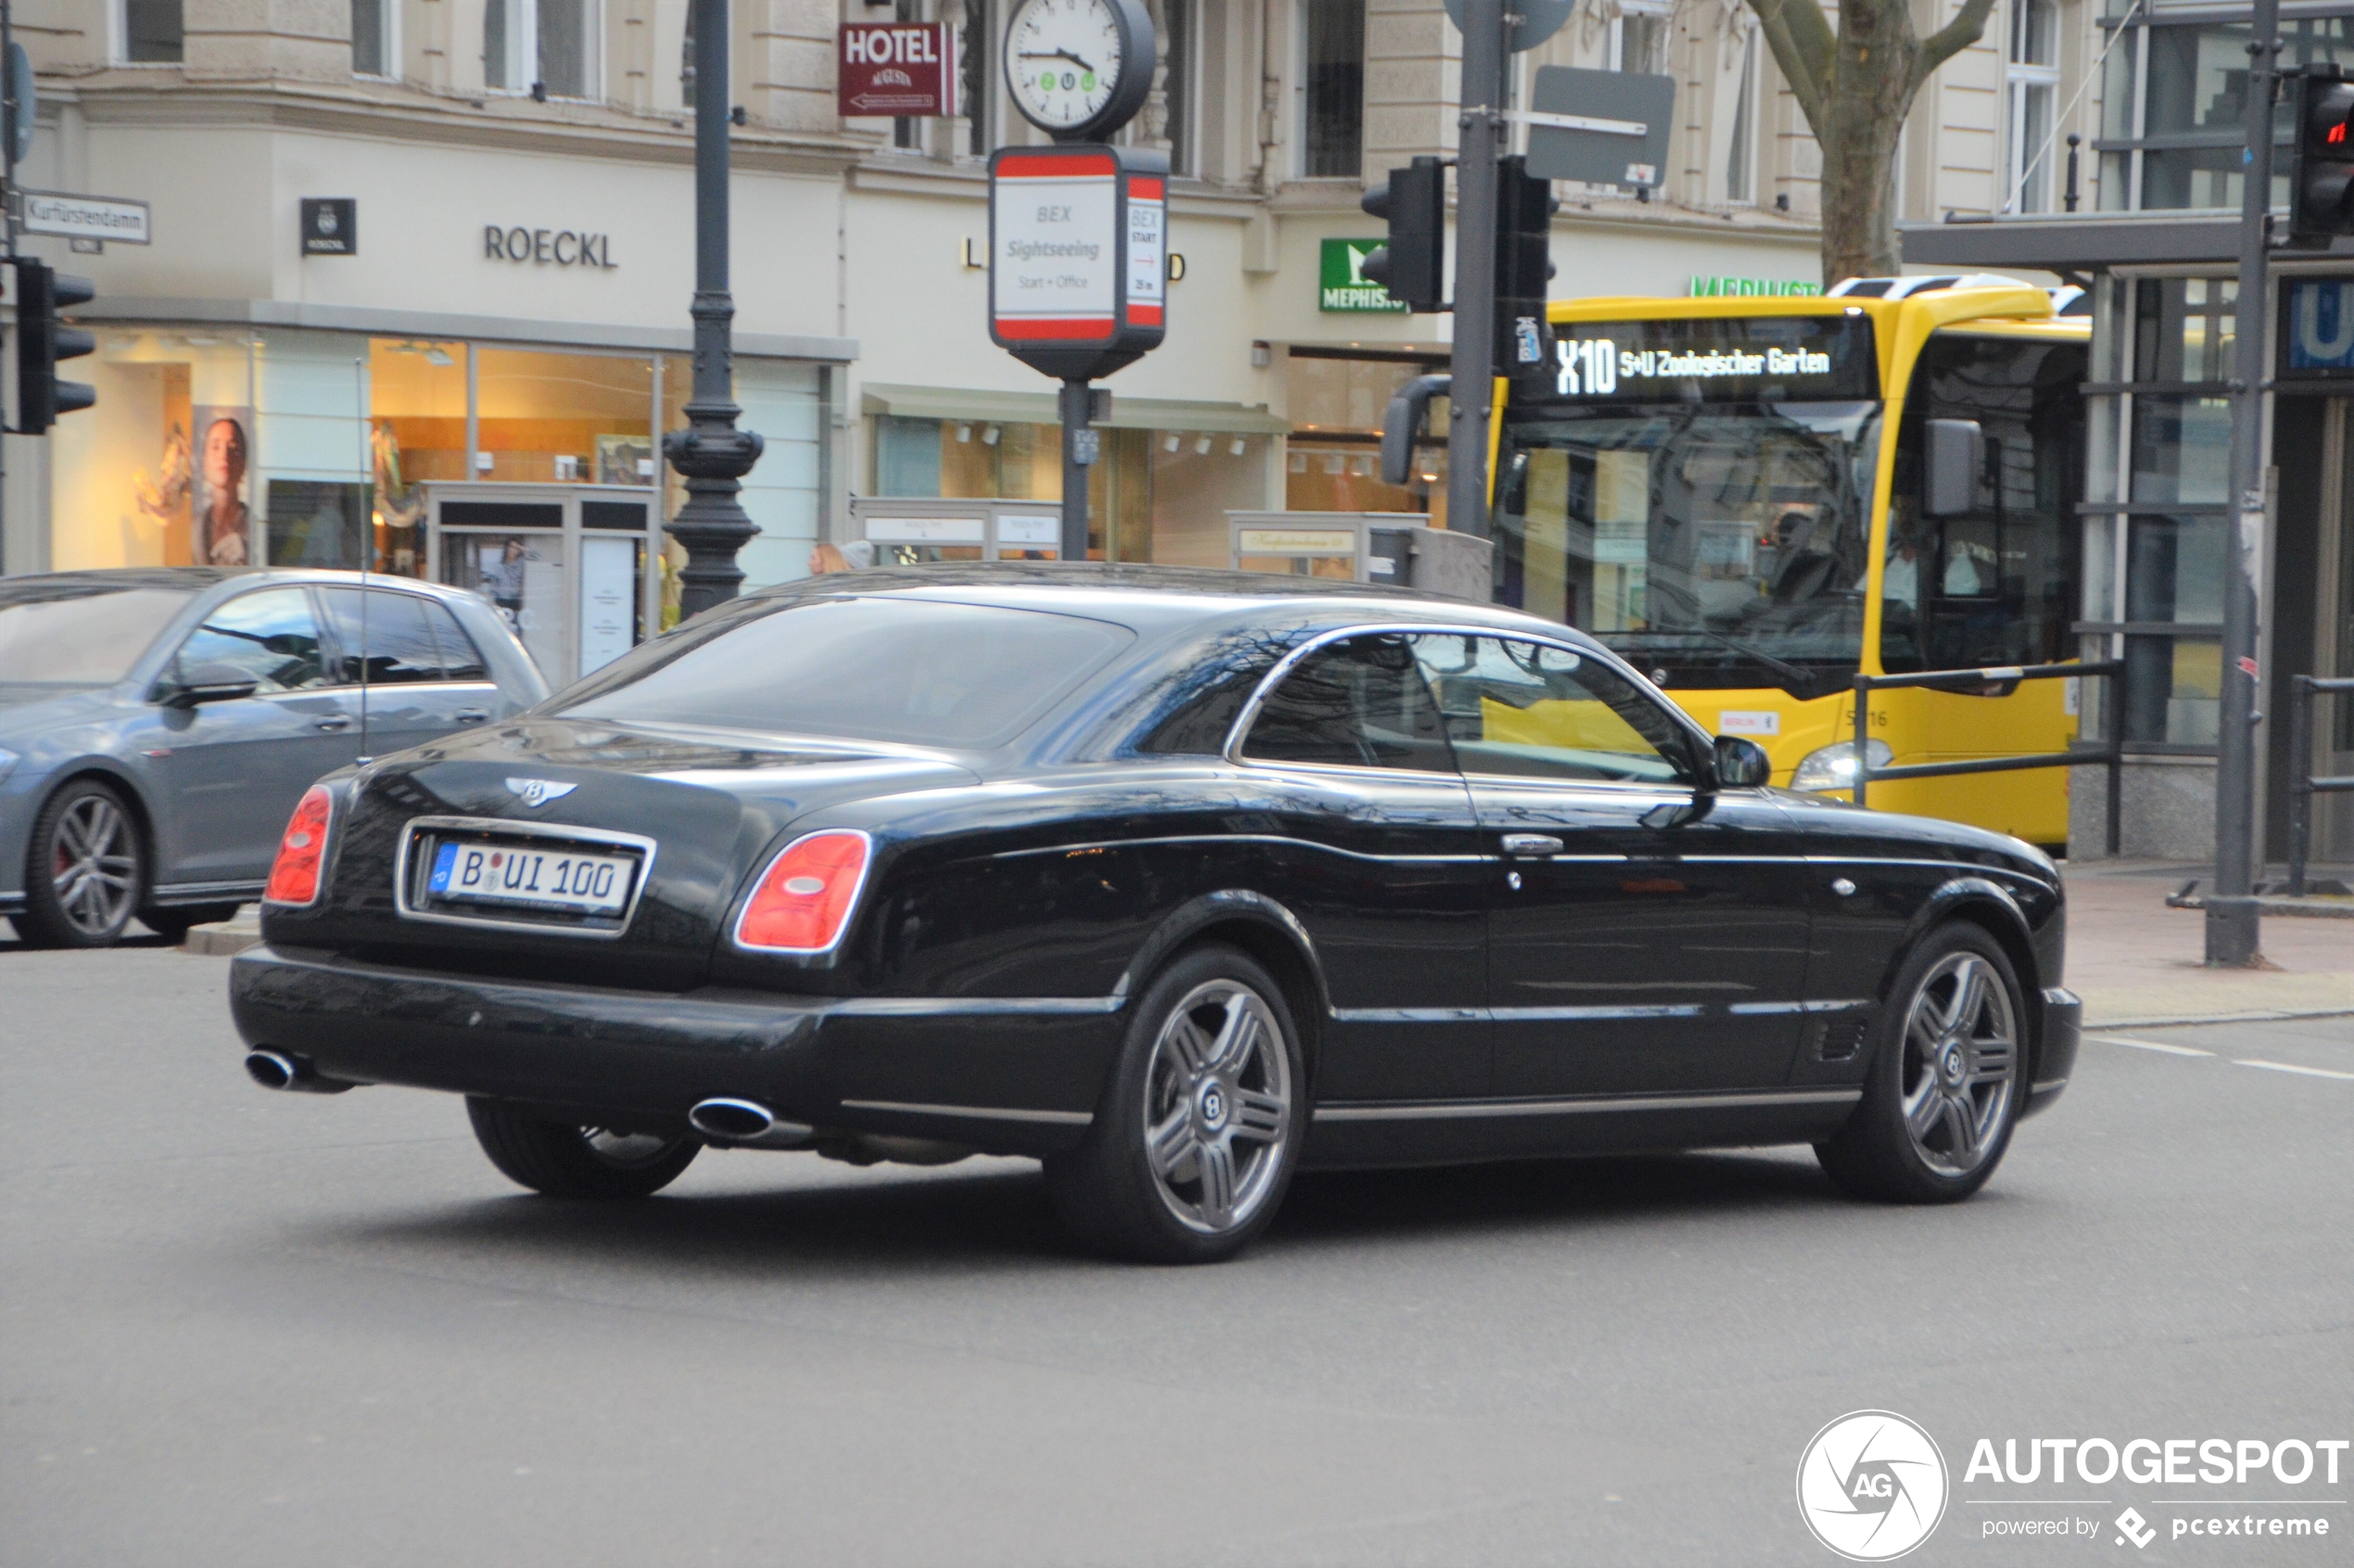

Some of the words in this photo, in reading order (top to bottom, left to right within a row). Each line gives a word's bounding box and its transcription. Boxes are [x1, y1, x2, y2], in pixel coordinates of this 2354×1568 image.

[846, 29, 938, 64] HOTEL
[1036, 206, 1072, 222] BEX
[1131, 209, 1158, 228] BEX
[485, 224, 618, 268] ROECKL
[1132, 232, 1157, 243] START
[1007, 240, 1100, 260] Sightseeing
[1019, 275, 1044, 289] Start
[1056, 275, 1088, 289] Office
[2299, 283, 2354, 360] U
[1557, 339, 1616, 395] X10
[1620, 350, 1656, 377] S+U
[1657, 348, 1766, 377] Zoologischer
[1767, 347, 1830, 374] Garten
[1846, 711, 1887, 726] 516
[462, 851, 484, 886] B
[504, 854, 544, 891] UI
[551, 859, 615, 899] 100
